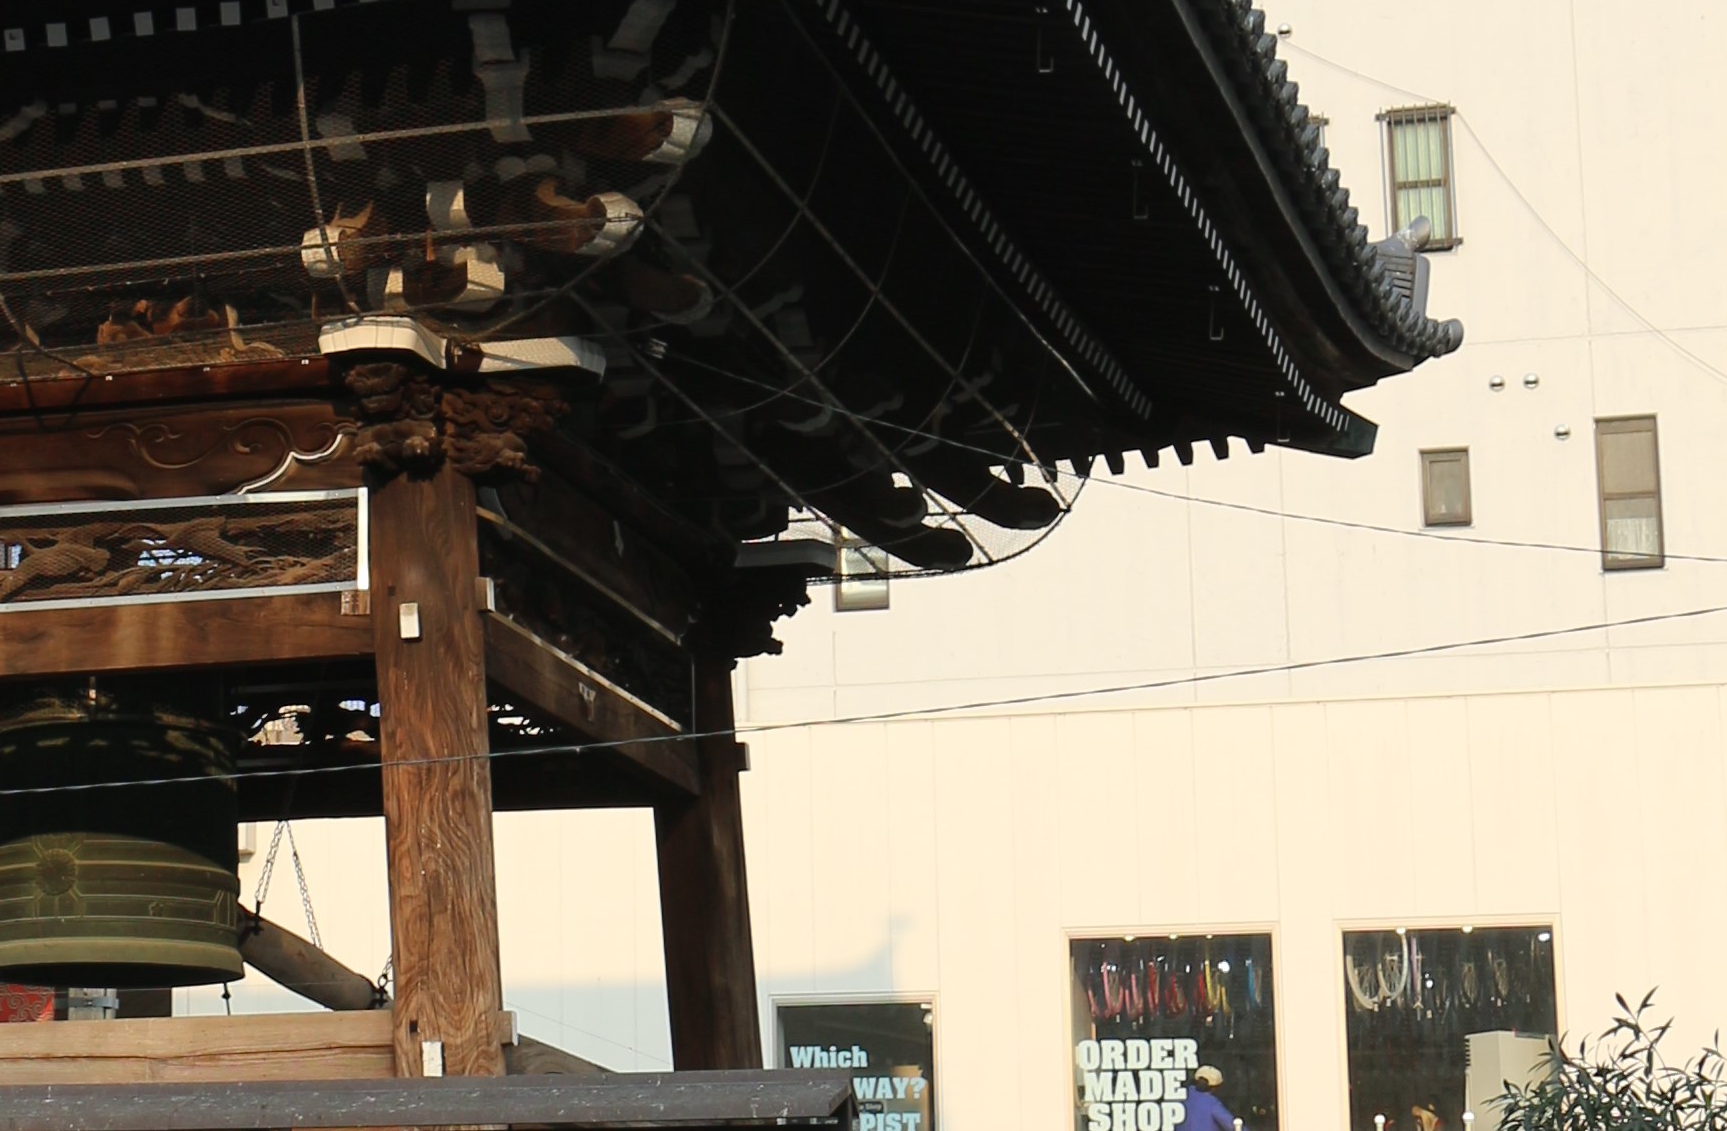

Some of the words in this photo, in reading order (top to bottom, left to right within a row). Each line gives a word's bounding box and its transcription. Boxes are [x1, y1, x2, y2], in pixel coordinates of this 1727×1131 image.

[789, 1045, 868, 1068] Which
[1077, 1039, 1199, 1069] ORDER
[853, 1076, 927, 1099] WAY?
[1084, 1070, 1187, 1101] MADE
[859, 1112, 921, 1131] PIST
[1087, 1102, 1186, 1131] SHOP
